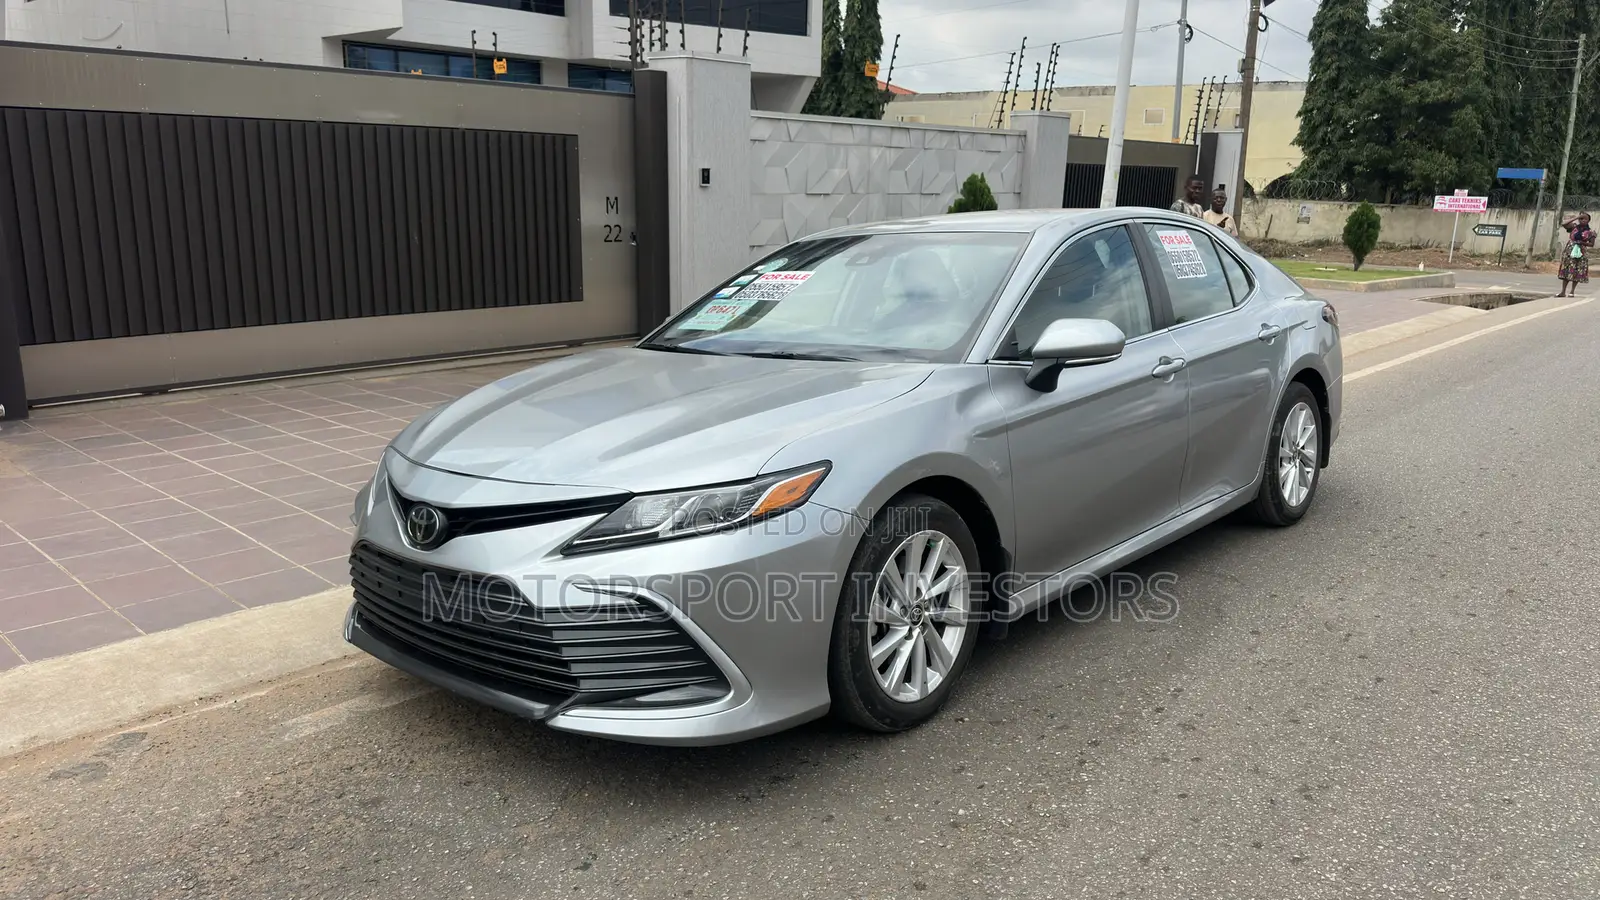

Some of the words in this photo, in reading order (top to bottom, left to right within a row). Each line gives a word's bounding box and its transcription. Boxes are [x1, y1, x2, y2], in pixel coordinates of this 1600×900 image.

[606, 196, 618, 214] M
[603, 224, 622, 242] 22
[1160, 235, 1177, 245] FOR
[1176, 235, 1193, 245] SALE
